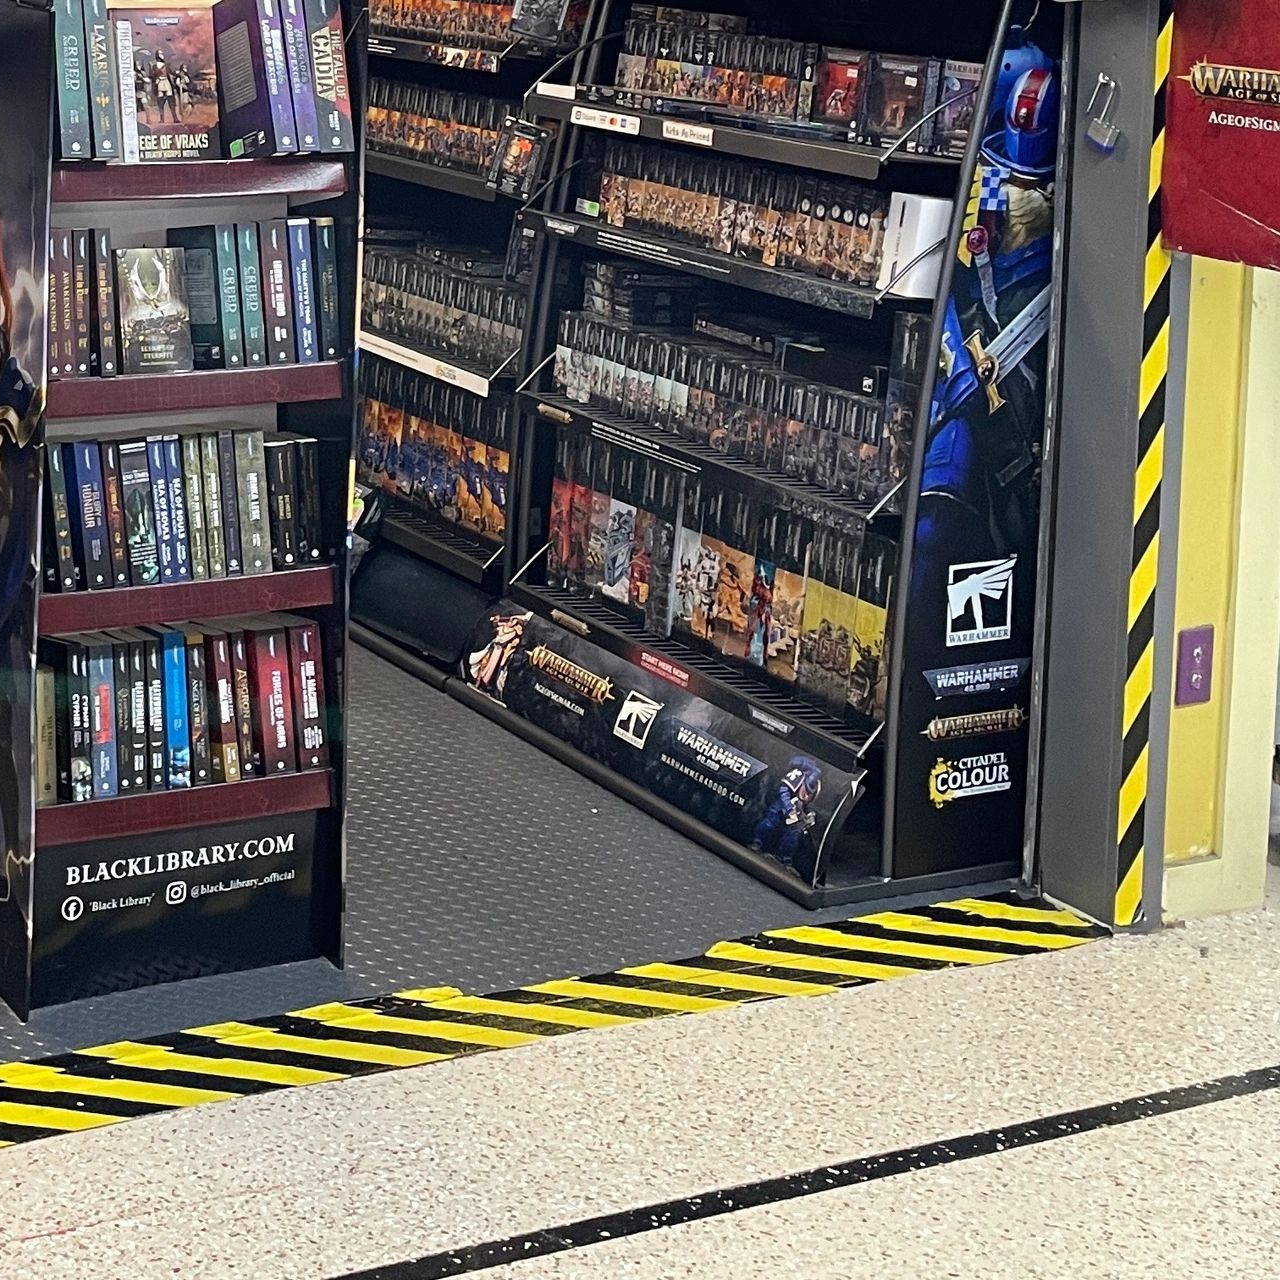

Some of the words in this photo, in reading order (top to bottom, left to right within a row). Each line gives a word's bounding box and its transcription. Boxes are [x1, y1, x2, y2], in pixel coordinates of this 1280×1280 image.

[261, 19, 271, 45] LORD
[330, 29, 340, 51] THE
[67, 35, 81, 91] CREED
[121, 44, 132, 82] RESTING
[265, 45, 274, 60] OF
[285, 18, 295, 44] LORD
[291, 59, 301, 94] EXCESS
[312, 34, 335, 96] CADIA
[267, 61, 279, 95] EXCESS
[333, 54, 344, 83] FALL
[336, 85, 347, 100] OF
[1226, 89, 1254, 100] AGE
[139, 135, 158, 150] EGE
[160, 135, 173, 150] OF
[175, 133, 209, 149] VRAKS
[689, 129, 710, 142] Priced
[145, 150, 162, 158] DEATH
[163, 150, 182, 158] KORPS
[183, 149, 200, 158] NOVEL
[225, 267, 237, 313] CREED
[247, 266, 259, 311] CREED
[82, 483, 96, 529] HONOUR
[948, 628, 1009, 644] WARHAMMER
[272, 670, 284, 706] FORGES
[936, 665, 1019, 689] WARHAMMER
[236, 669, 251, 719] ANGRON
[72, 693, 81, 727] CYPHER
[275, 706, 285, 719] OF
[276, 720, 287, 749] MARS
[928, 710, 1021, 740] WARHAMMER
[677, 726, 752, 778] WARHAMMER
[958, 752, 1007, 770] CITADEL
[936, 764, 1010, 792] COLOUR
[65, 833, 296, 886] BLACKLIBRARY.COM
[190, 870, 296, 898] @black_library_official
